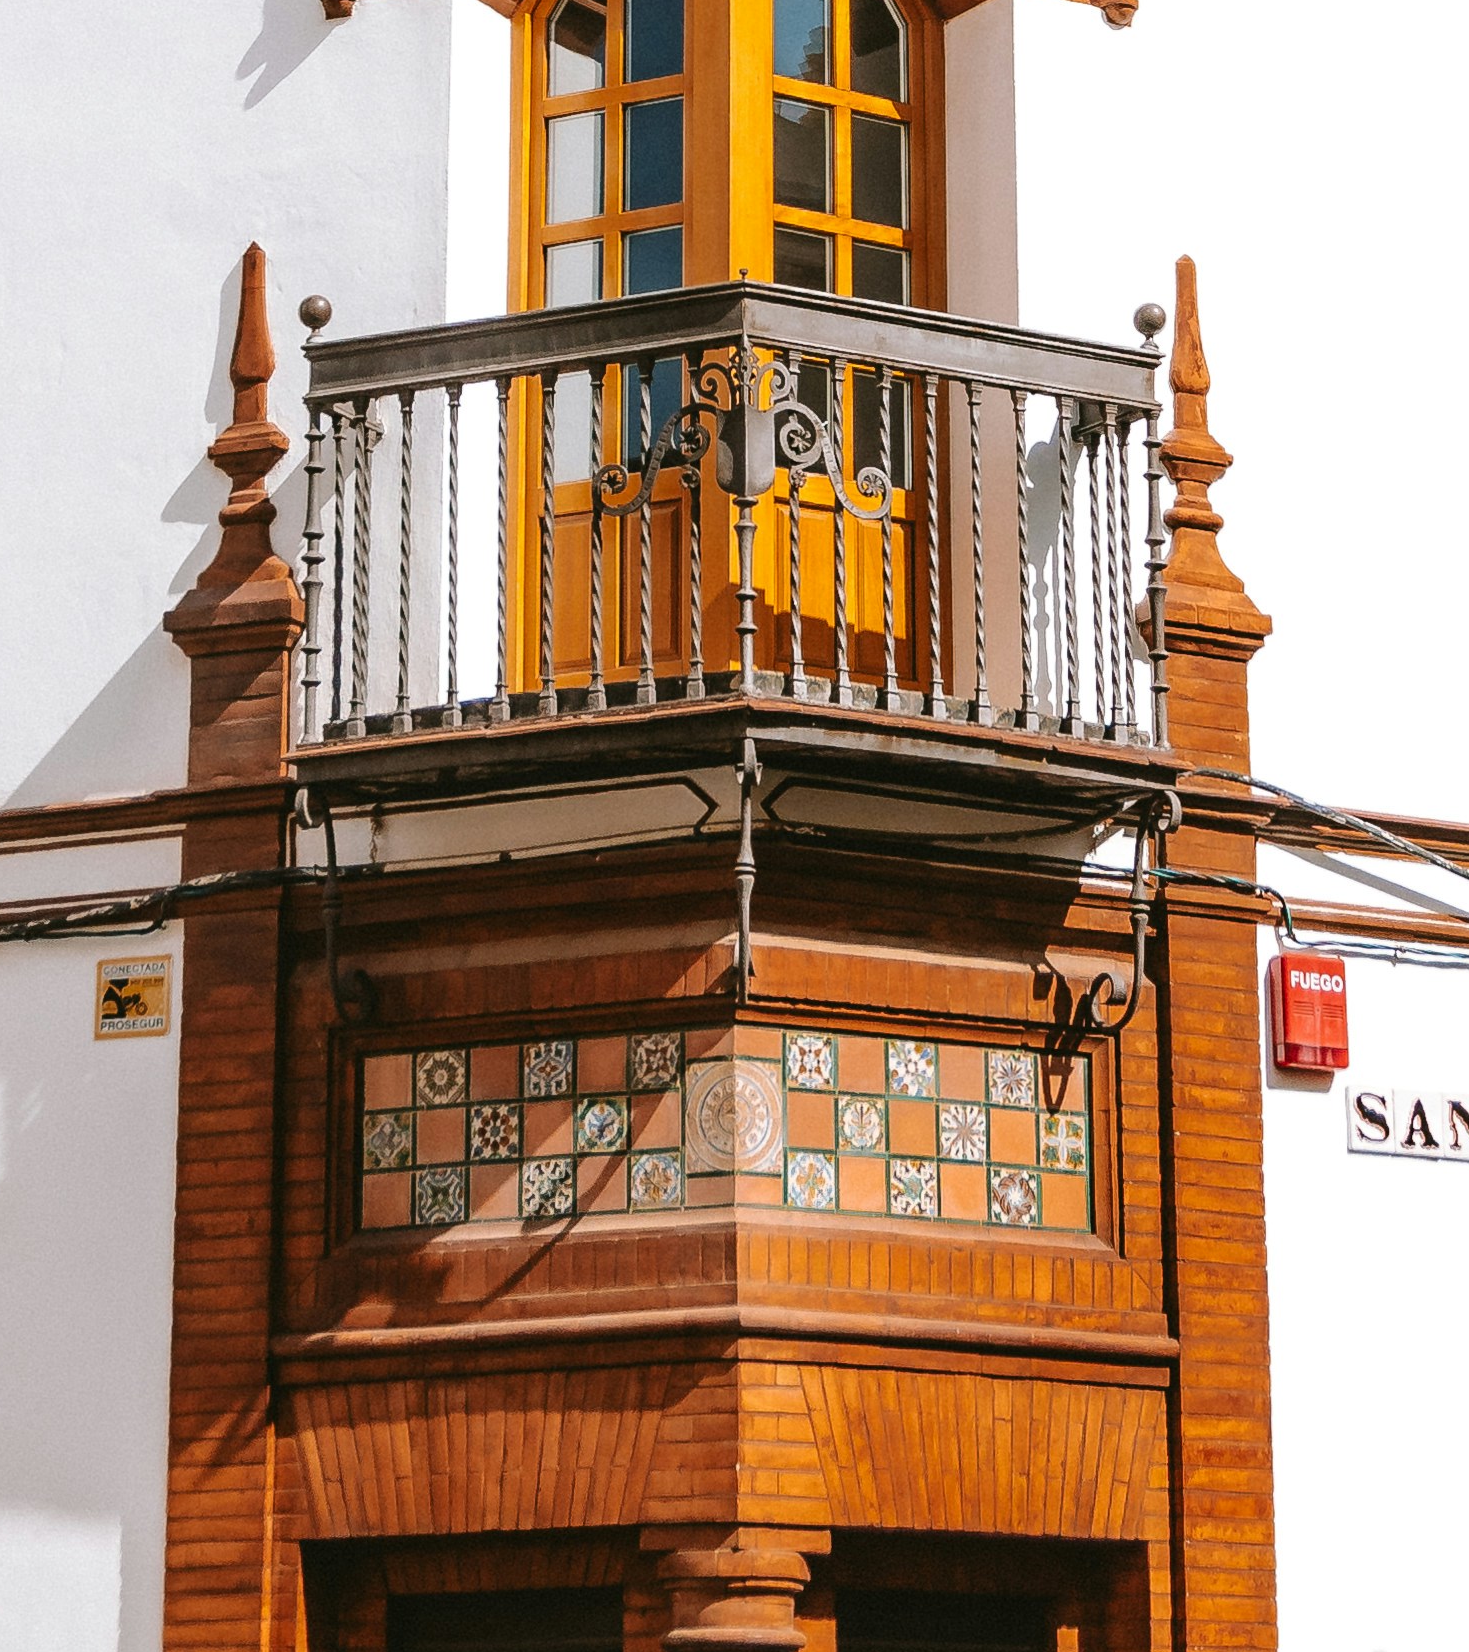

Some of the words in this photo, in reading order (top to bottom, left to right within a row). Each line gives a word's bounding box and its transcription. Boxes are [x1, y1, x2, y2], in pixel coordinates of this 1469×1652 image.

[103, 963, 166, 976] CONECTADA
[1289, 969, 1344, 993] FUEGO
[100, 1018, 164, 1031] PROSEGUR
